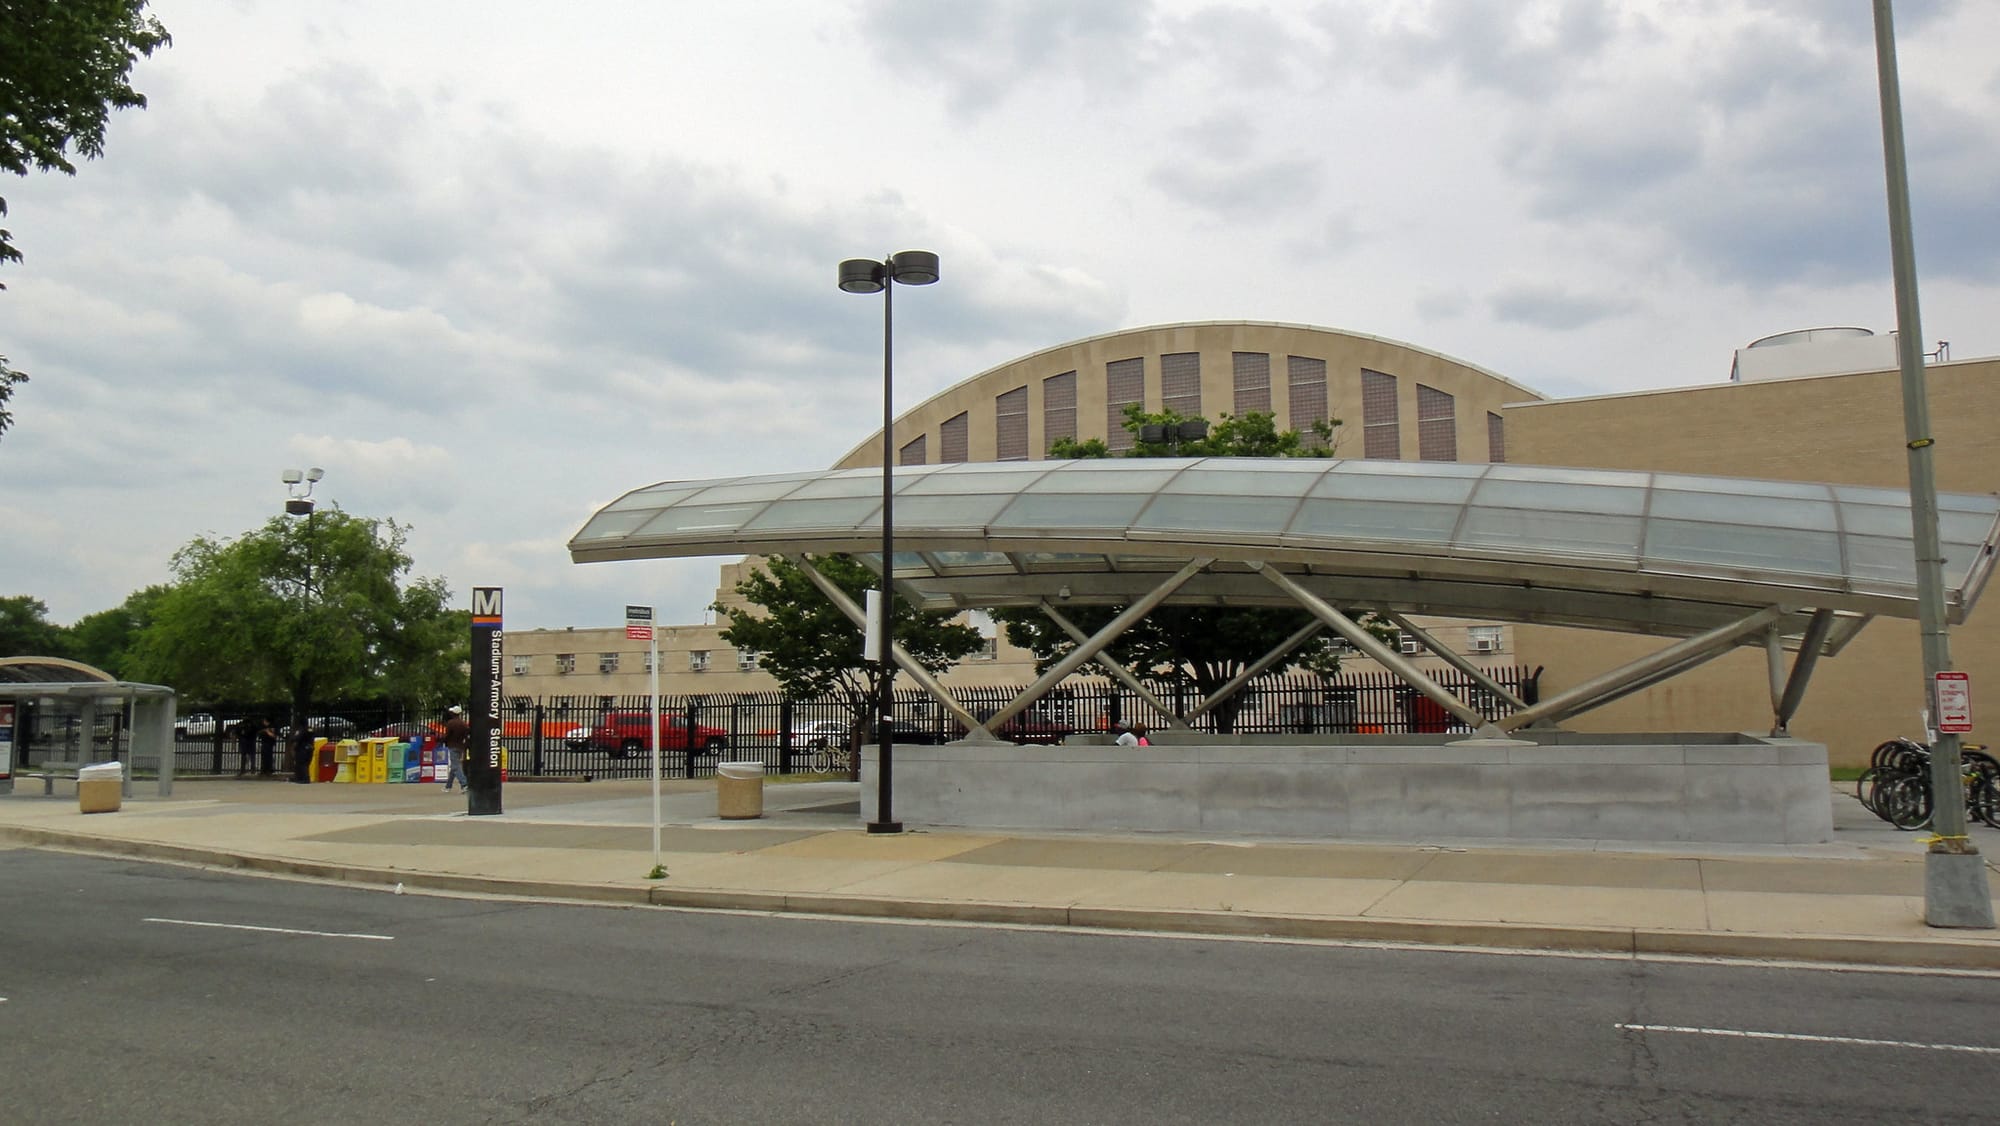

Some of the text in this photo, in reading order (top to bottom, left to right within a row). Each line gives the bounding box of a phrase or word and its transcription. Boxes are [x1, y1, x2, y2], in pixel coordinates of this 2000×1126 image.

[474, 590, 501, 616] M
[489, 630, 502, 768] Stadium-Armory Station
